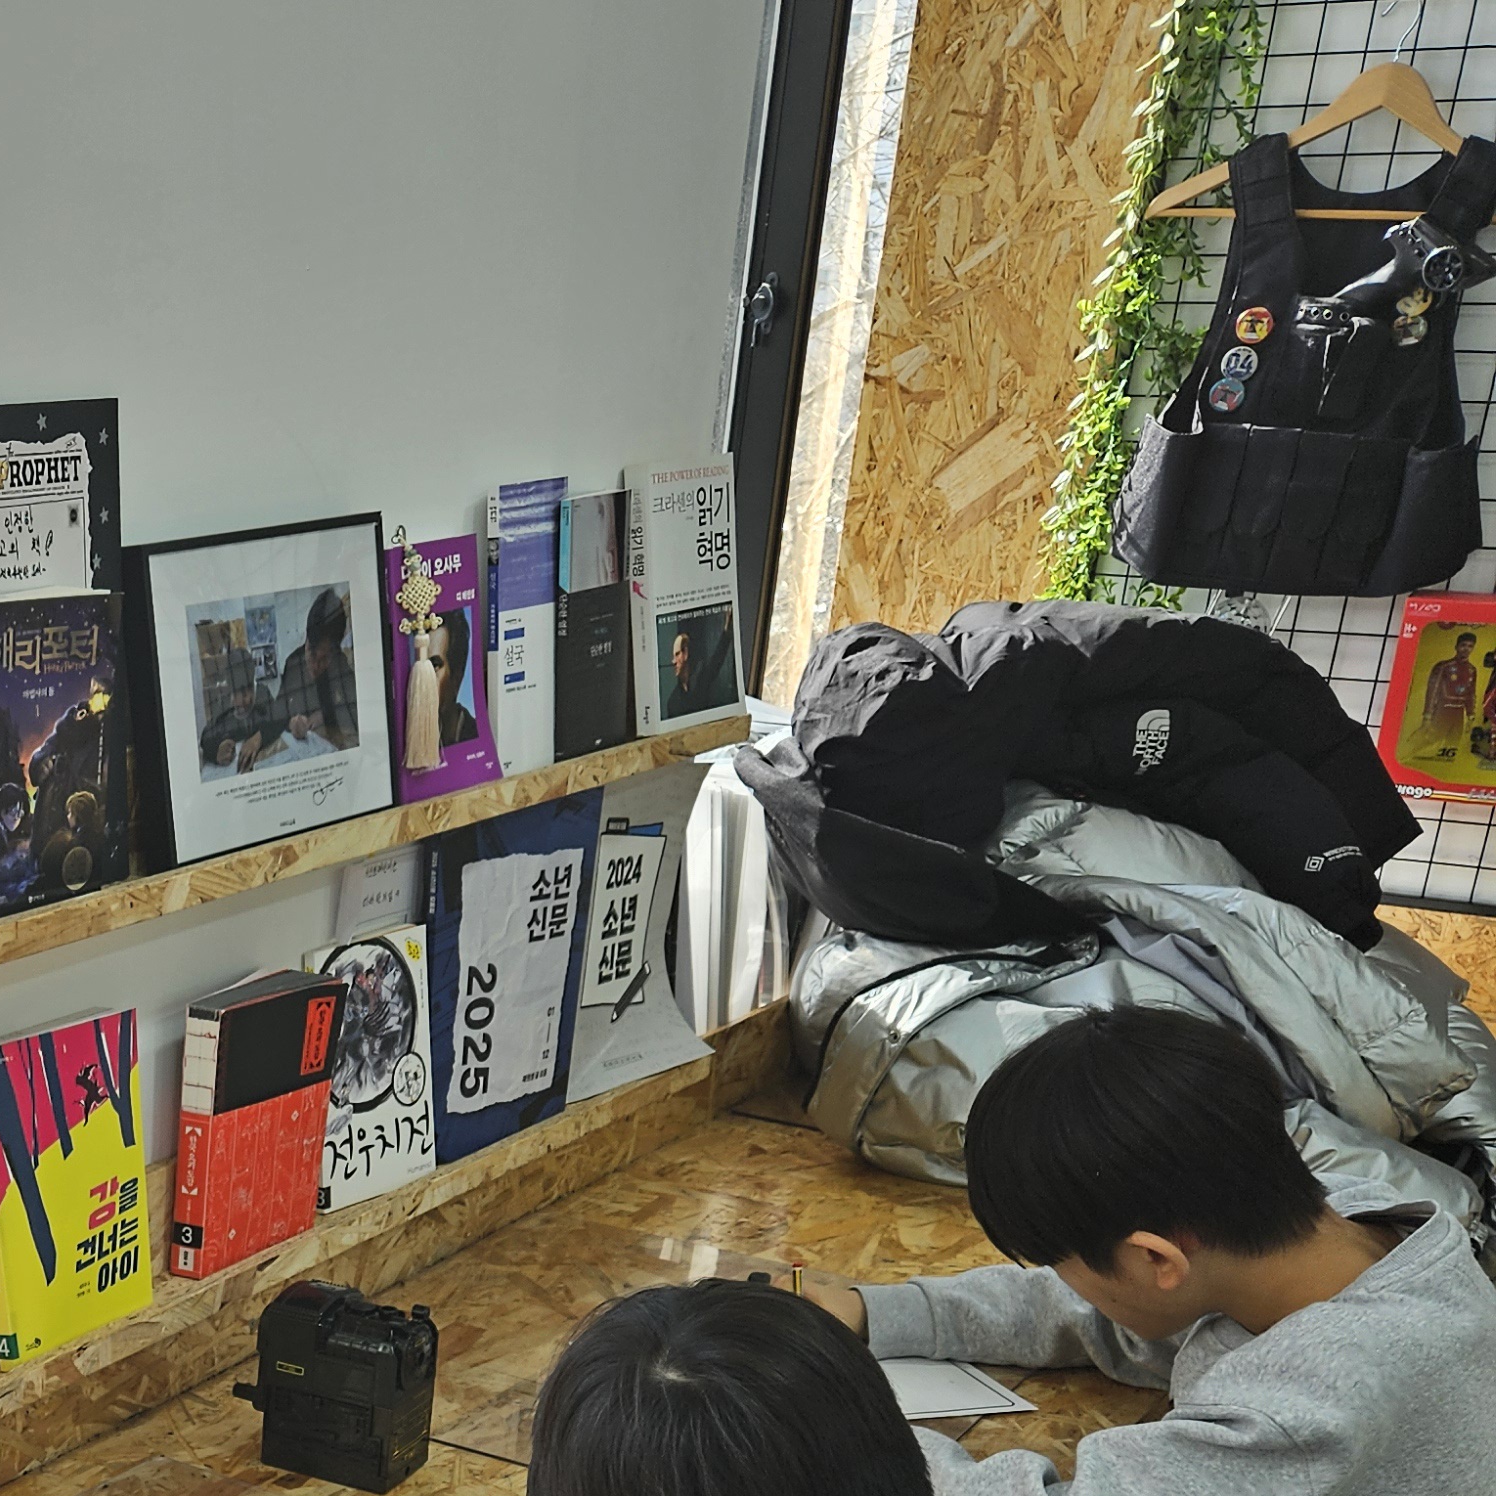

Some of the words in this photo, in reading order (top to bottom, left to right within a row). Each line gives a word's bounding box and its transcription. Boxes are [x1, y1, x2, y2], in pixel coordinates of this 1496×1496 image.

[652, 472, 668, 484] THE
[670, 470, 693, 482] POWER
[4, 505, 34, 534] 인정한
[652, 490, 695, 514] 크라센의
[696, 482, 730, 526] 읽기
[632, 526, 644, 551] 읽기
[696, 528, 731, 571] 혁명
[433, 553, 462, 576] 오사무
[632, 554, 645, 577] 혁명
[505, 644, 525, 667] 설국
[1132, 730, 1147, 756] THE
[1151, 731, 1169, 765] FACE
[529, 864, 573, 902] 소년
[606, 854, 643, 890] 2024
[526, 903, 568, 944] 신문
[601, 894, 638, 940] 소년
[598, 939, 633, 985] 신문
[459, 963, 498, 1098] 2025
[324, 1100, 434, 1181] 전우치전
[88, 1176, 139, 1231] 강을
[75, 1217, 139, 1274] 건너는
[181, 1226, 193, 1244] 3
[97, 1245, 139, 1293] 아이
